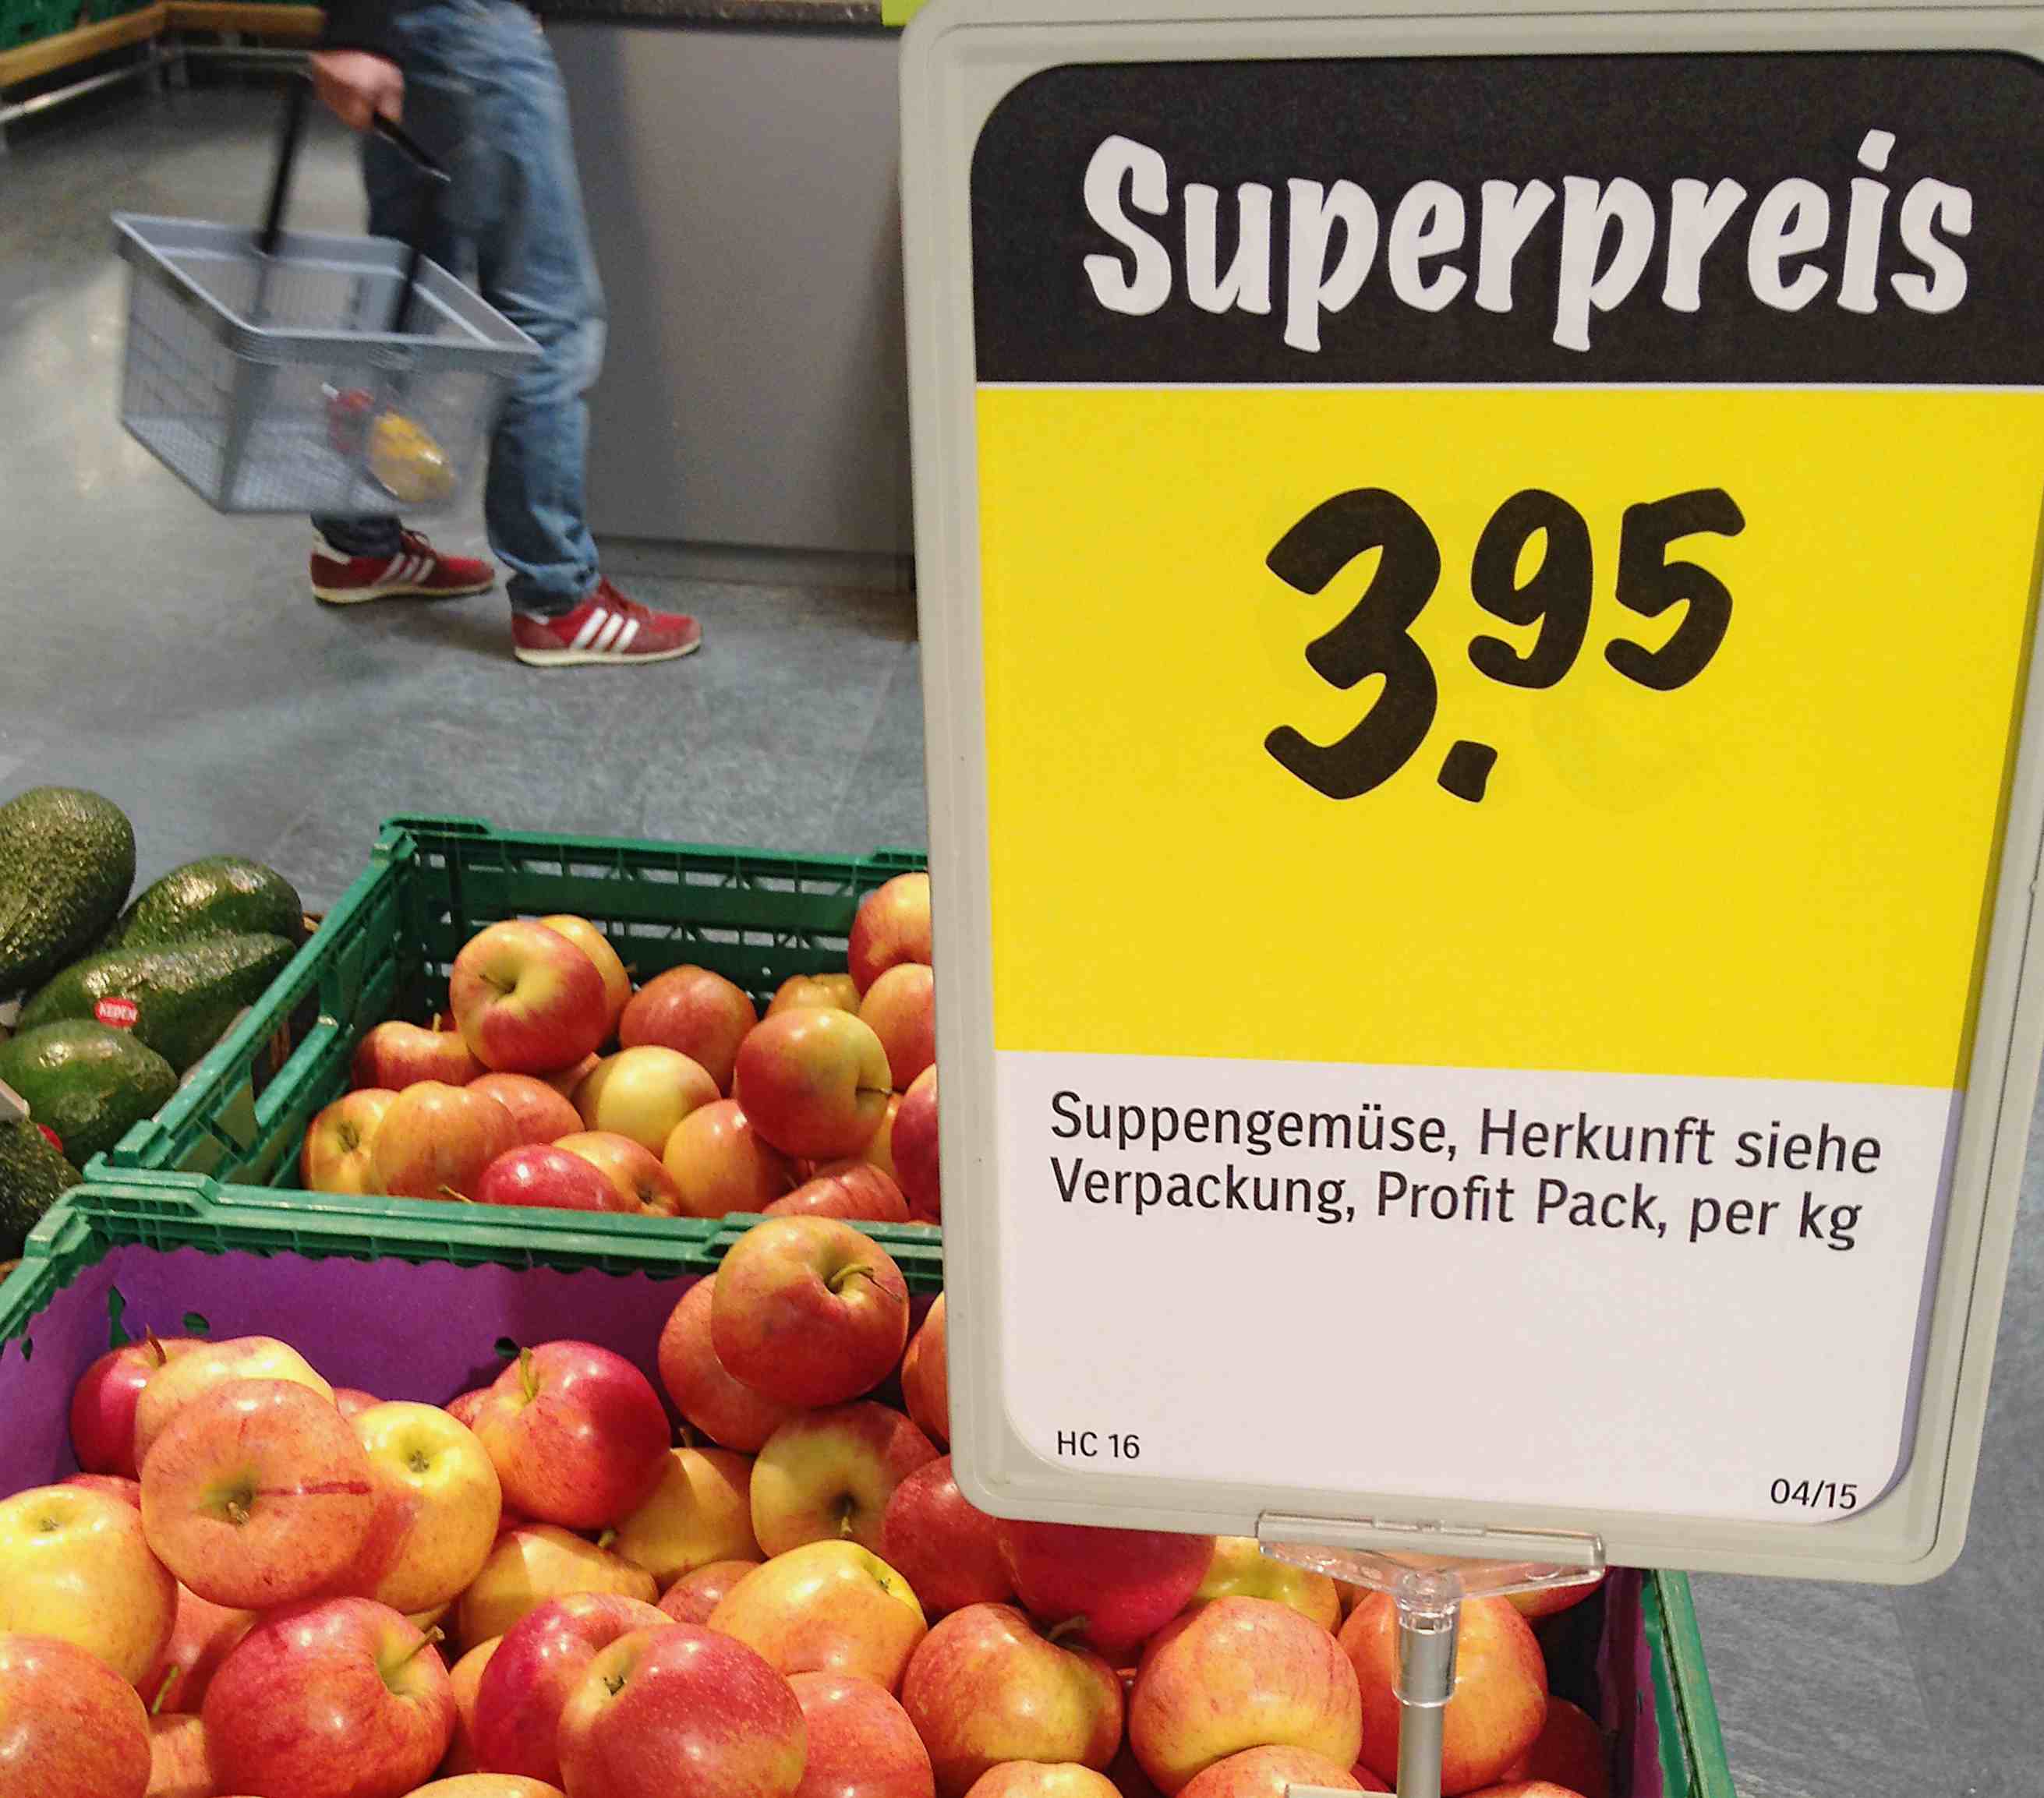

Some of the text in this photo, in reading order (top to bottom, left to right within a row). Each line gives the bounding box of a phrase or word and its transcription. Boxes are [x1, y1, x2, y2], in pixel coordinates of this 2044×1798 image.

[1083, 129, 1973, 353] Superpreis
[1264, 487, 1746, 804] 3.95
[1051, 1090, 1881, 1174] Suppengemüse, Herkunft siehe
[1050, 1157, 1863, 1252] Verpackung, Profit Pack, per kg
[1057, 1430, 1140, 1459] HC 16
[1770, 1478, 1858, 1510] 04/15
